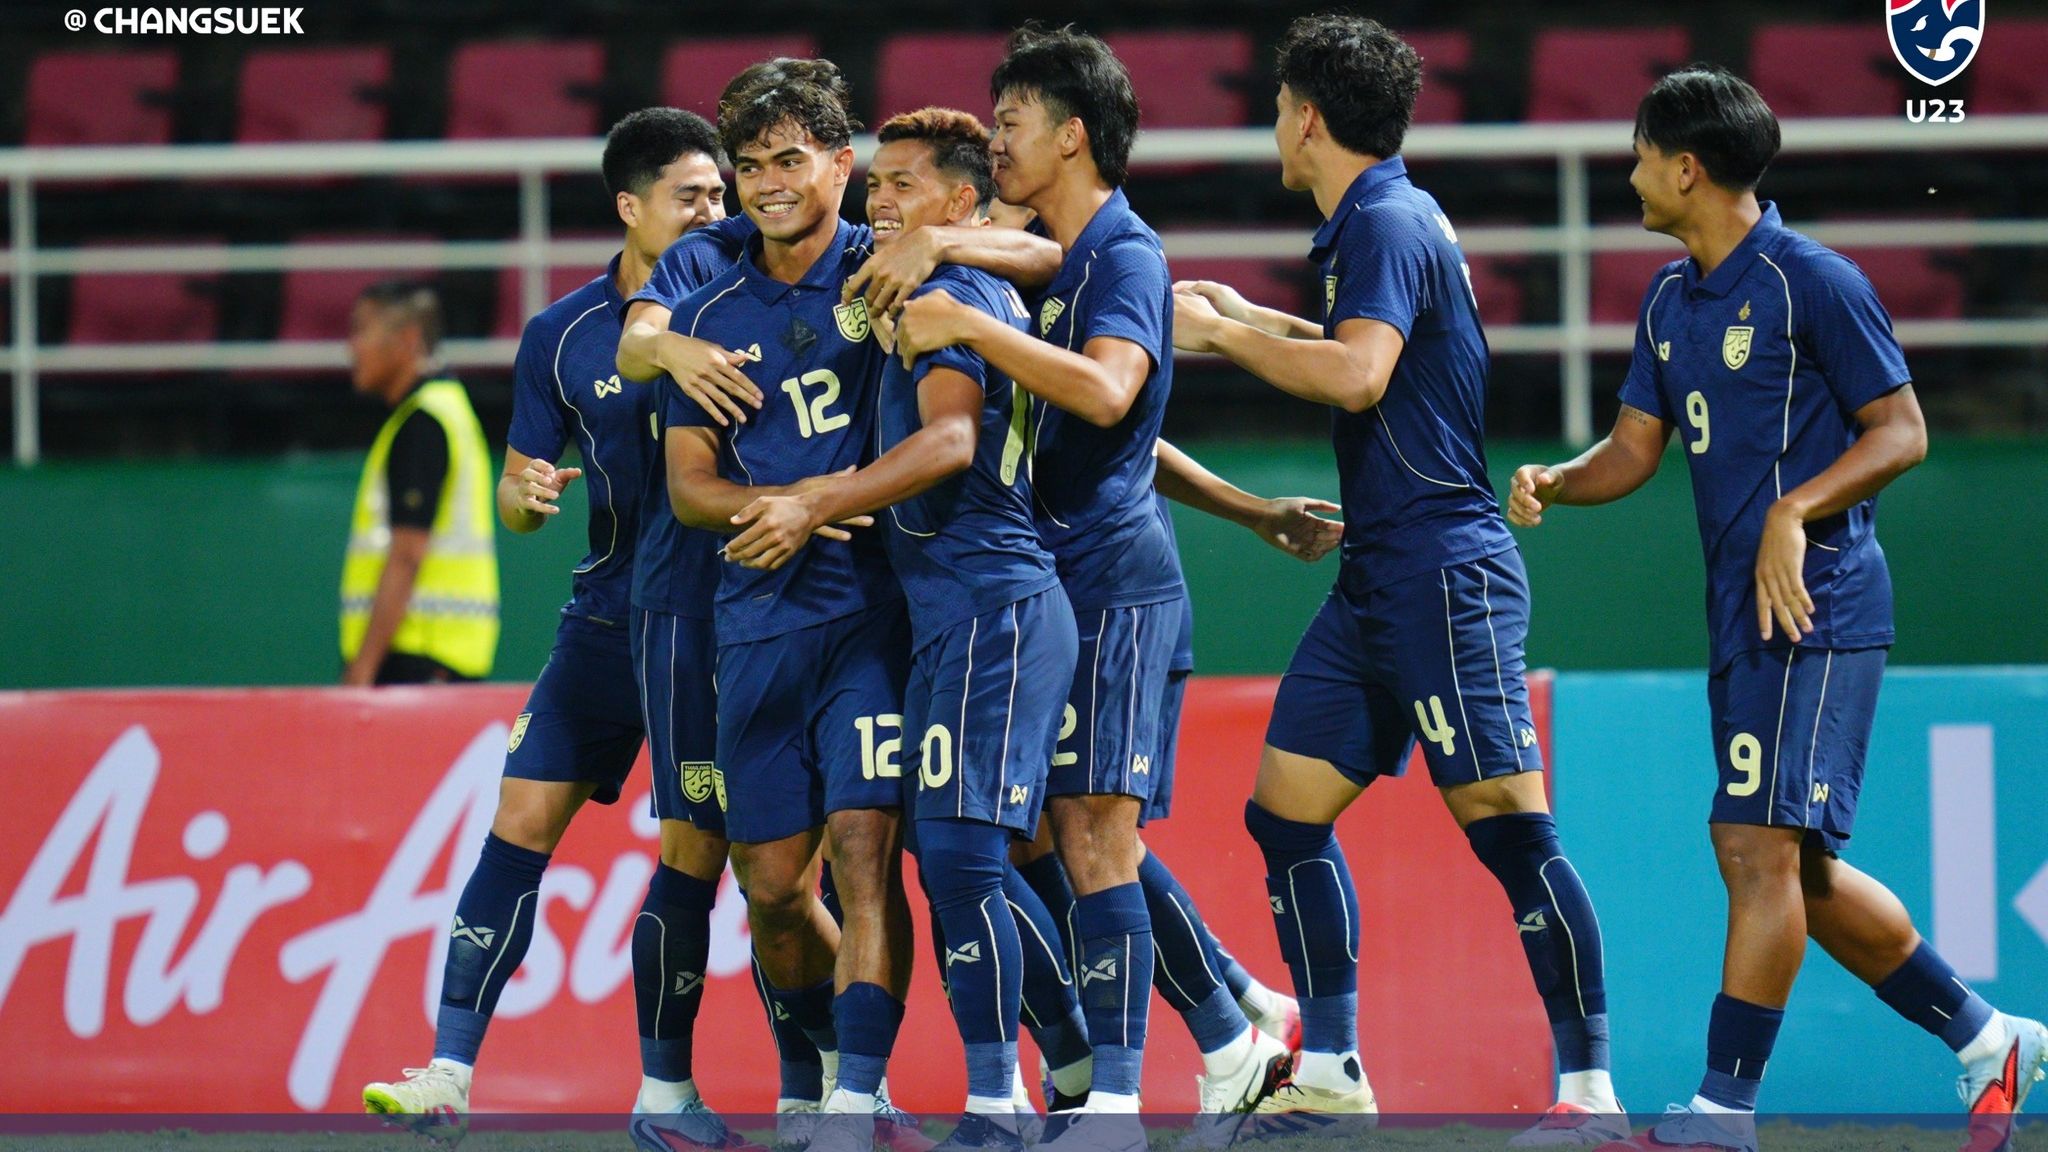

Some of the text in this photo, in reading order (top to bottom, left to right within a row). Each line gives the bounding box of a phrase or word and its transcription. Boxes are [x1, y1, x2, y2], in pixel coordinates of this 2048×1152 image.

[781, 369, 850, 438] 12
[1686, 391, 1710, 454] 9
[854, 714, 903, 780] 12
[919, 724, 952, 791] 0
[1414, 695, 1456, 756] 4
[1726, 733, 1761, 796] 9
